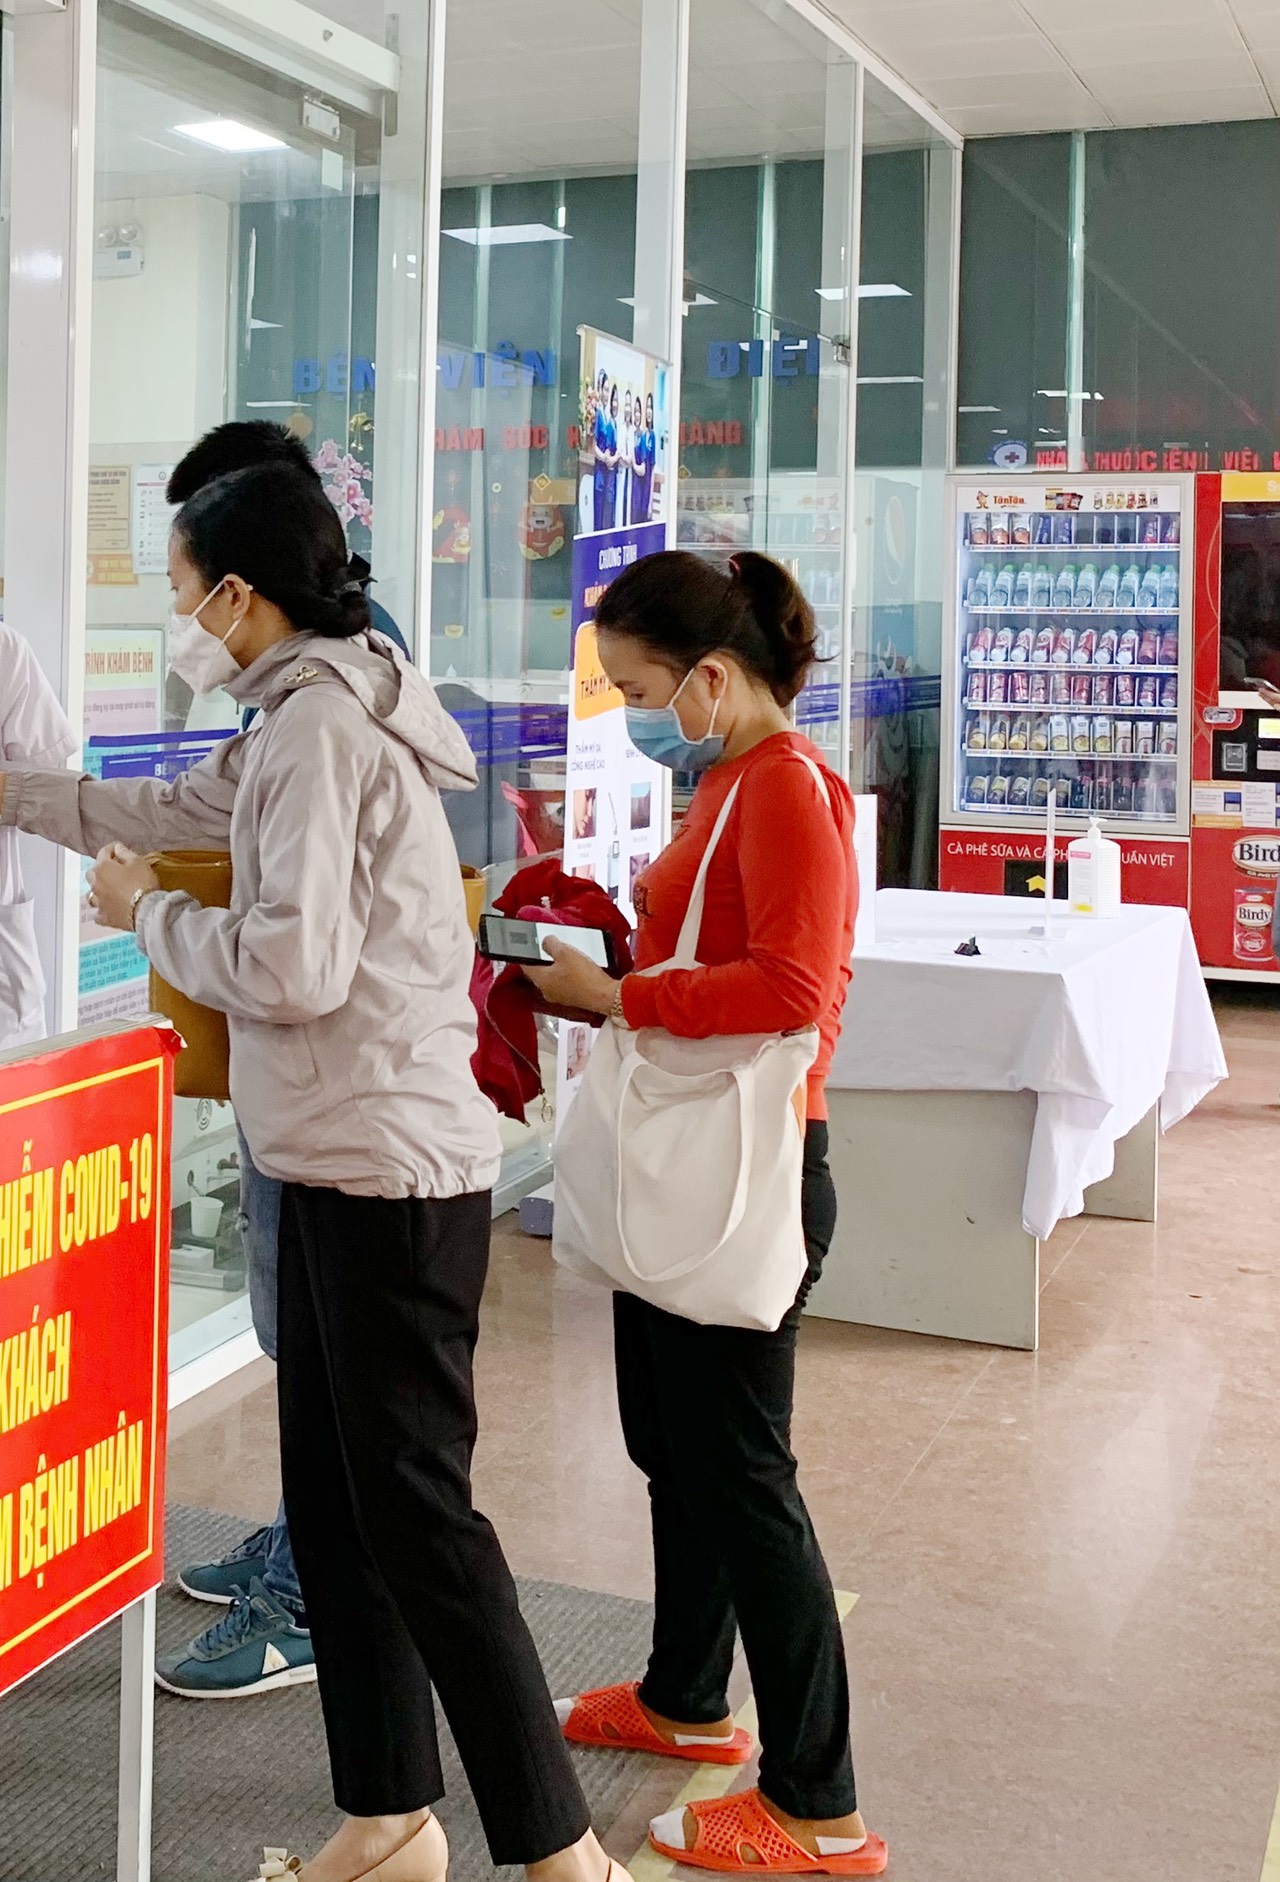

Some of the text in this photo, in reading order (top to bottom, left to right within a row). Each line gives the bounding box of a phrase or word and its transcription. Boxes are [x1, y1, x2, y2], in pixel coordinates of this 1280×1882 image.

[294, 350, 376, 401] BỆN
[438, 339, 558, 398] VIỆN
[85, 646, 154, 678] RÌNH KHÁM BỆNH
[947, 842, 963, 855] CÀ
[966, 842, 988, 856] PHÊ
[991, 843, 1014, 857] SỮA
[1016, 844, 1031, 858] VÀ
[1053, 848, 1069, 860] PH
[1121, 850, 1148, 865] UẨN
[1150, 853, 1175, 869] VIỆT
[1239, 842, 1280, 863] Bird
[1238, 906, 1272, 922] Birdy
[58, 1132, 153, 1254] COVID-19
[18, 1454, 79, 1590] BỆNH
[83, 1410, 144, 1539] NHÂN
